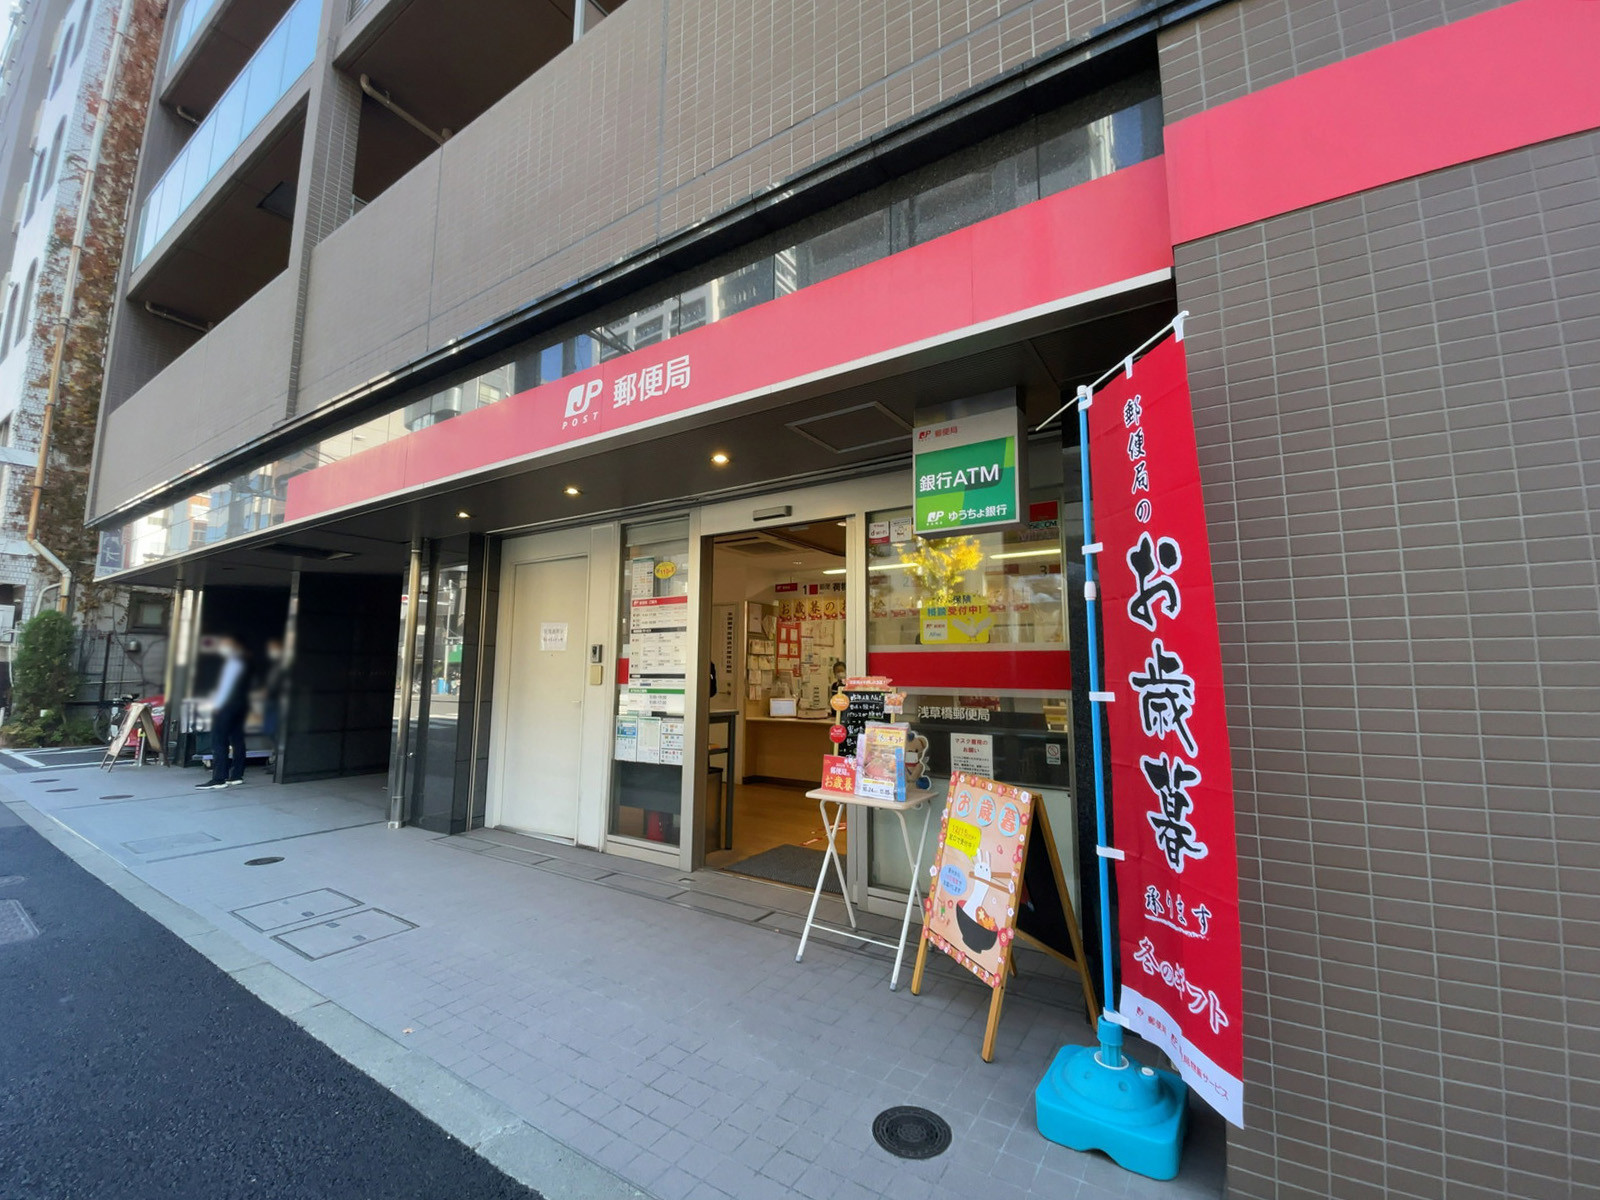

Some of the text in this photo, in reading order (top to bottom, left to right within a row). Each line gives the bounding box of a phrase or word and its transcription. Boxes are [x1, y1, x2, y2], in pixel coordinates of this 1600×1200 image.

[613, 354, 690, 409] 郵便局
[562, 412, 598, 430] POST
[919, 463, 999, 492] 銀行ATM
[1123, 394, 1152, 524] 郵便局の
[948, 503, 1008, 522] ゆうちょ銀行
[917, 706, 991, 722] 浅草橋郵便局
[1126, 529, 1209, 874] お歳暮
[825, 775, 853, 791] お歳暮
[957, 793, 1017, 833] お歳暮
[1144, 885, 1212, 935] 承ります
[1133, 935, 1229, 1035] 冬のギフト
